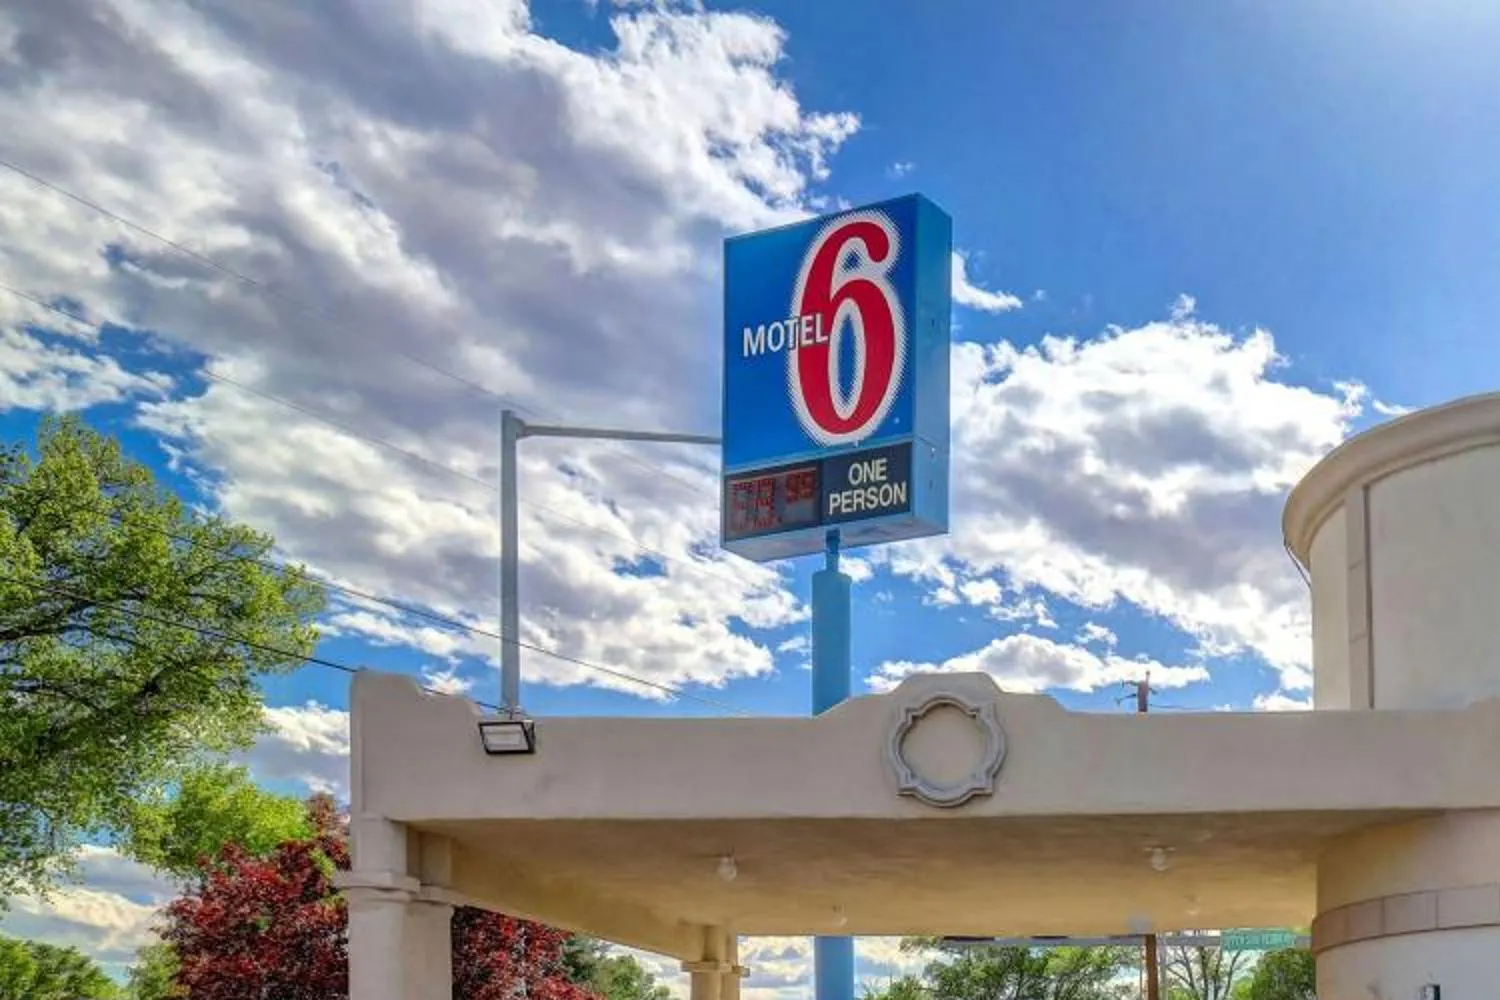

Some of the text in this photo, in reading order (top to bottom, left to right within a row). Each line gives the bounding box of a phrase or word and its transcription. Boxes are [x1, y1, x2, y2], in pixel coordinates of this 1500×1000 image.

[743, 221, 896, 434] MOTEL 6
[848, 457, 887, 485] ONE
[828, 481, 908, 516] PERSON
